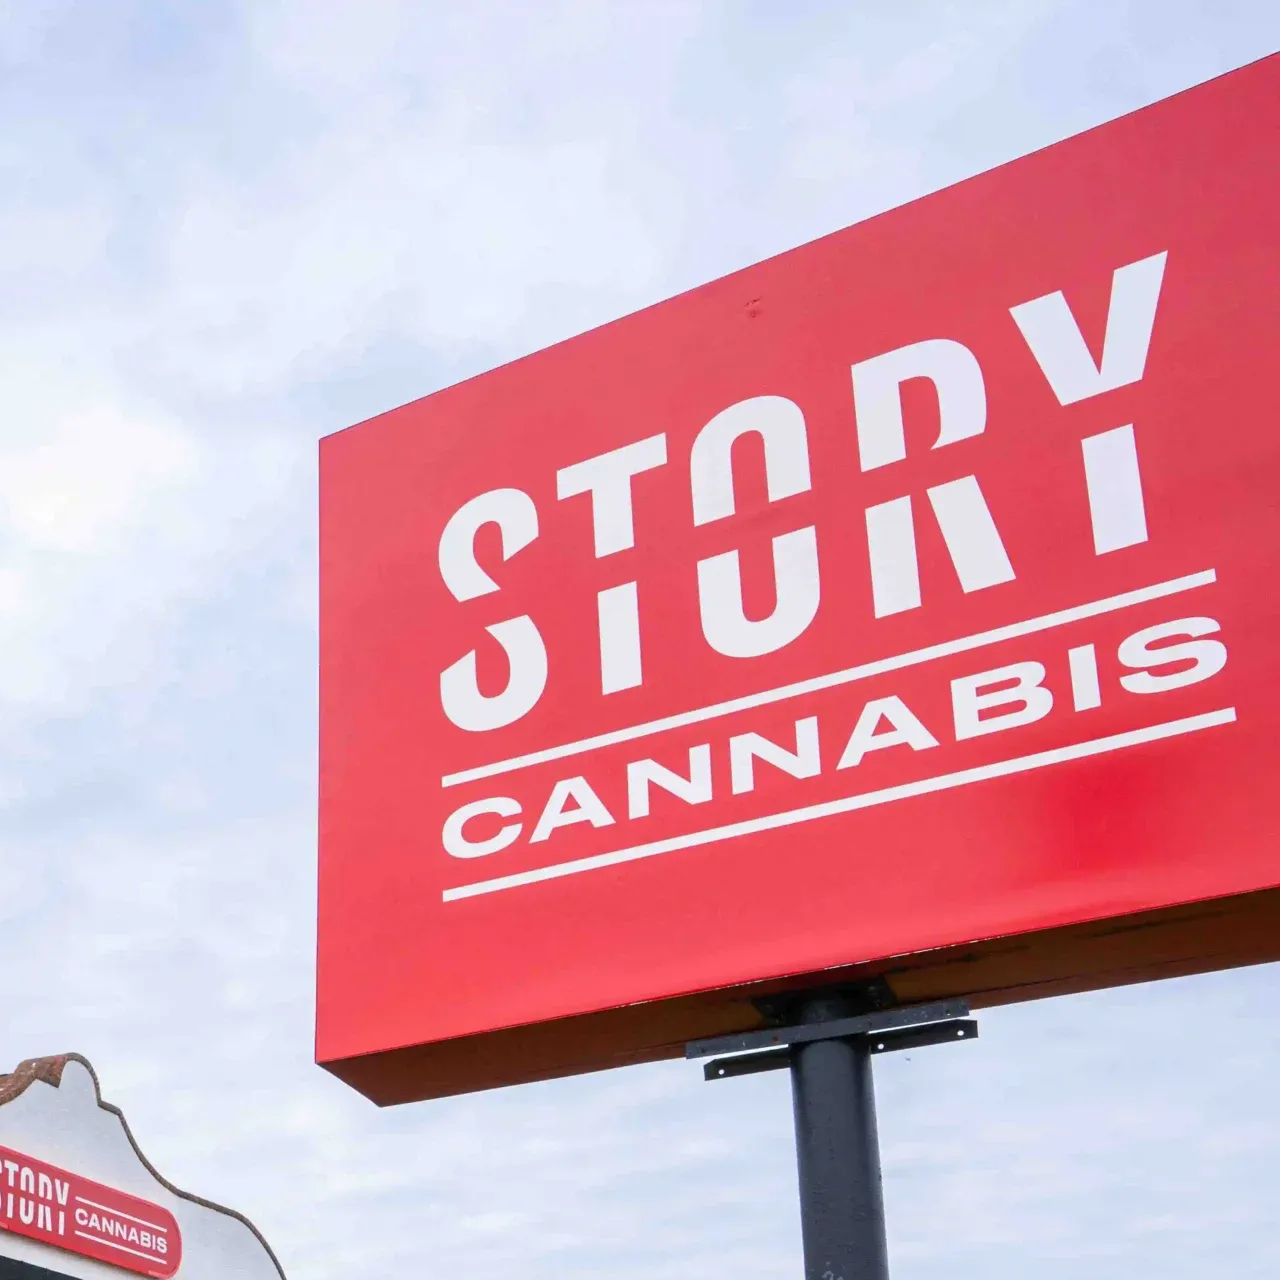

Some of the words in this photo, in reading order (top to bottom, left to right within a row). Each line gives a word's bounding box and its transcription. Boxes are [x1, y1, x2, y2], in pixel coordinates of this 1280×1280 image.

[438, 250, 1168, 732] STORY
[442, 616, 1228, 859] CANNABIS
[74, 1208, 168, 1254] CANNABIS
